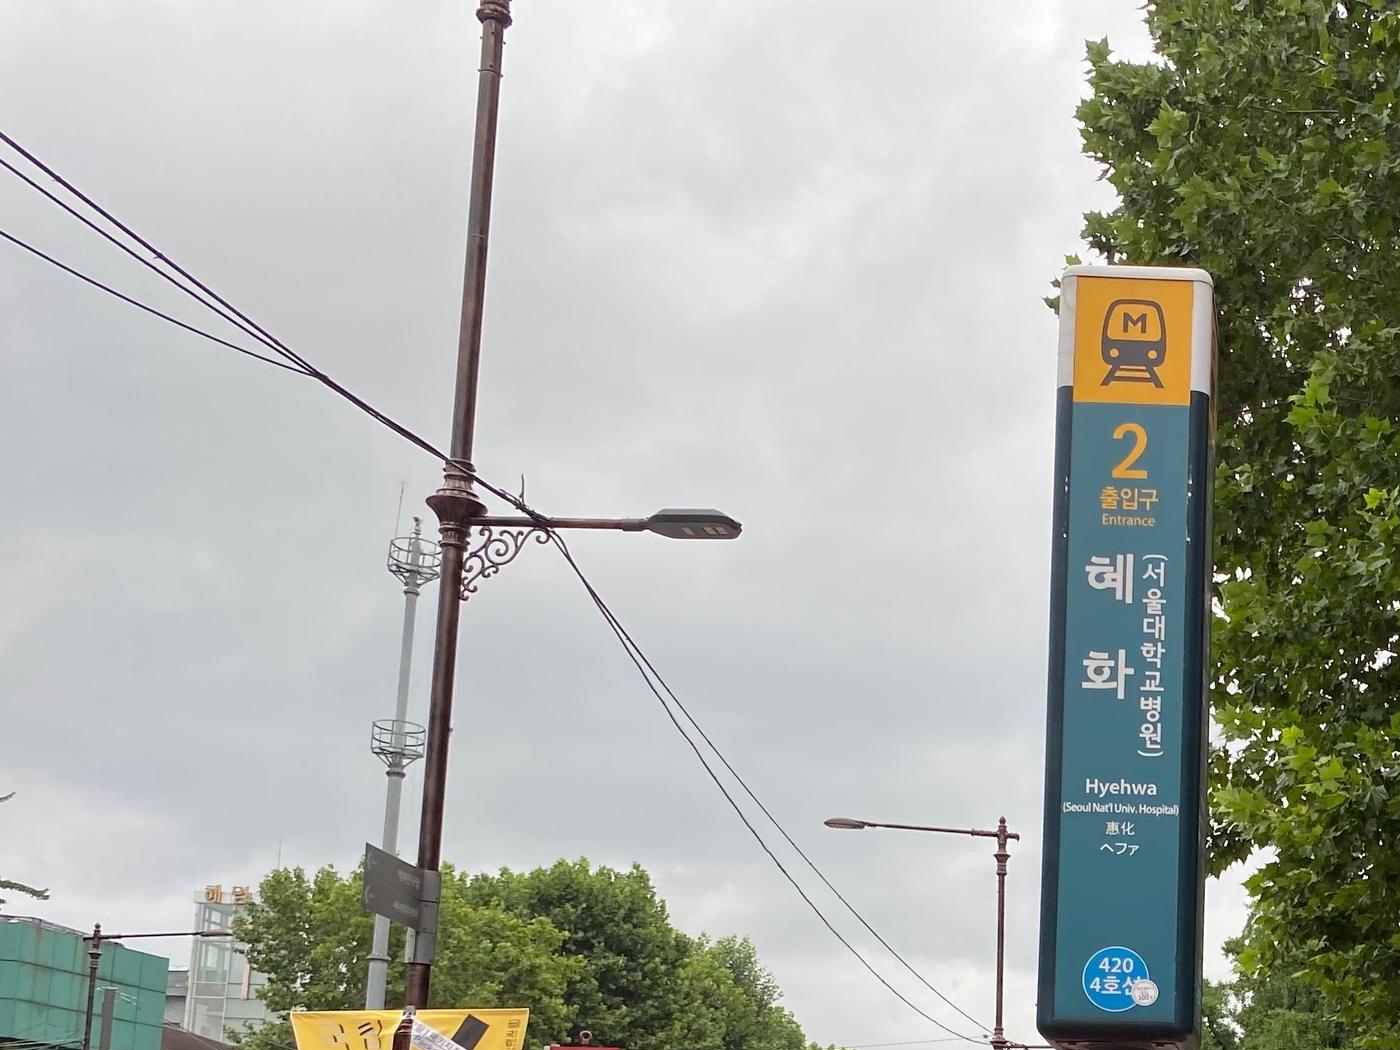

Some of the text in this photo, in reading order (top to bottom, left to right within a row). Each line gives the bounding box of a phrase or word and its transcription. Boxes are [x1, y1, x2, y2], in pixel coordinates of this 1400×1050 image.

[1123, 312, 1147, 334] M
[1112, 423, 1148, 479] 2
[1100, 487, 1159, 511] 출입구
[1102, 514, 1156, 527] Entrance
[1137, 554, 1168, 757] (서울대학교병원)
[1085, 778, 1157, 797] Hyehwa
[1063, 802, 1179, 817] (Seoul Nat'l Univ. Hospital)
[1099, 957, 1134, 973] 420
